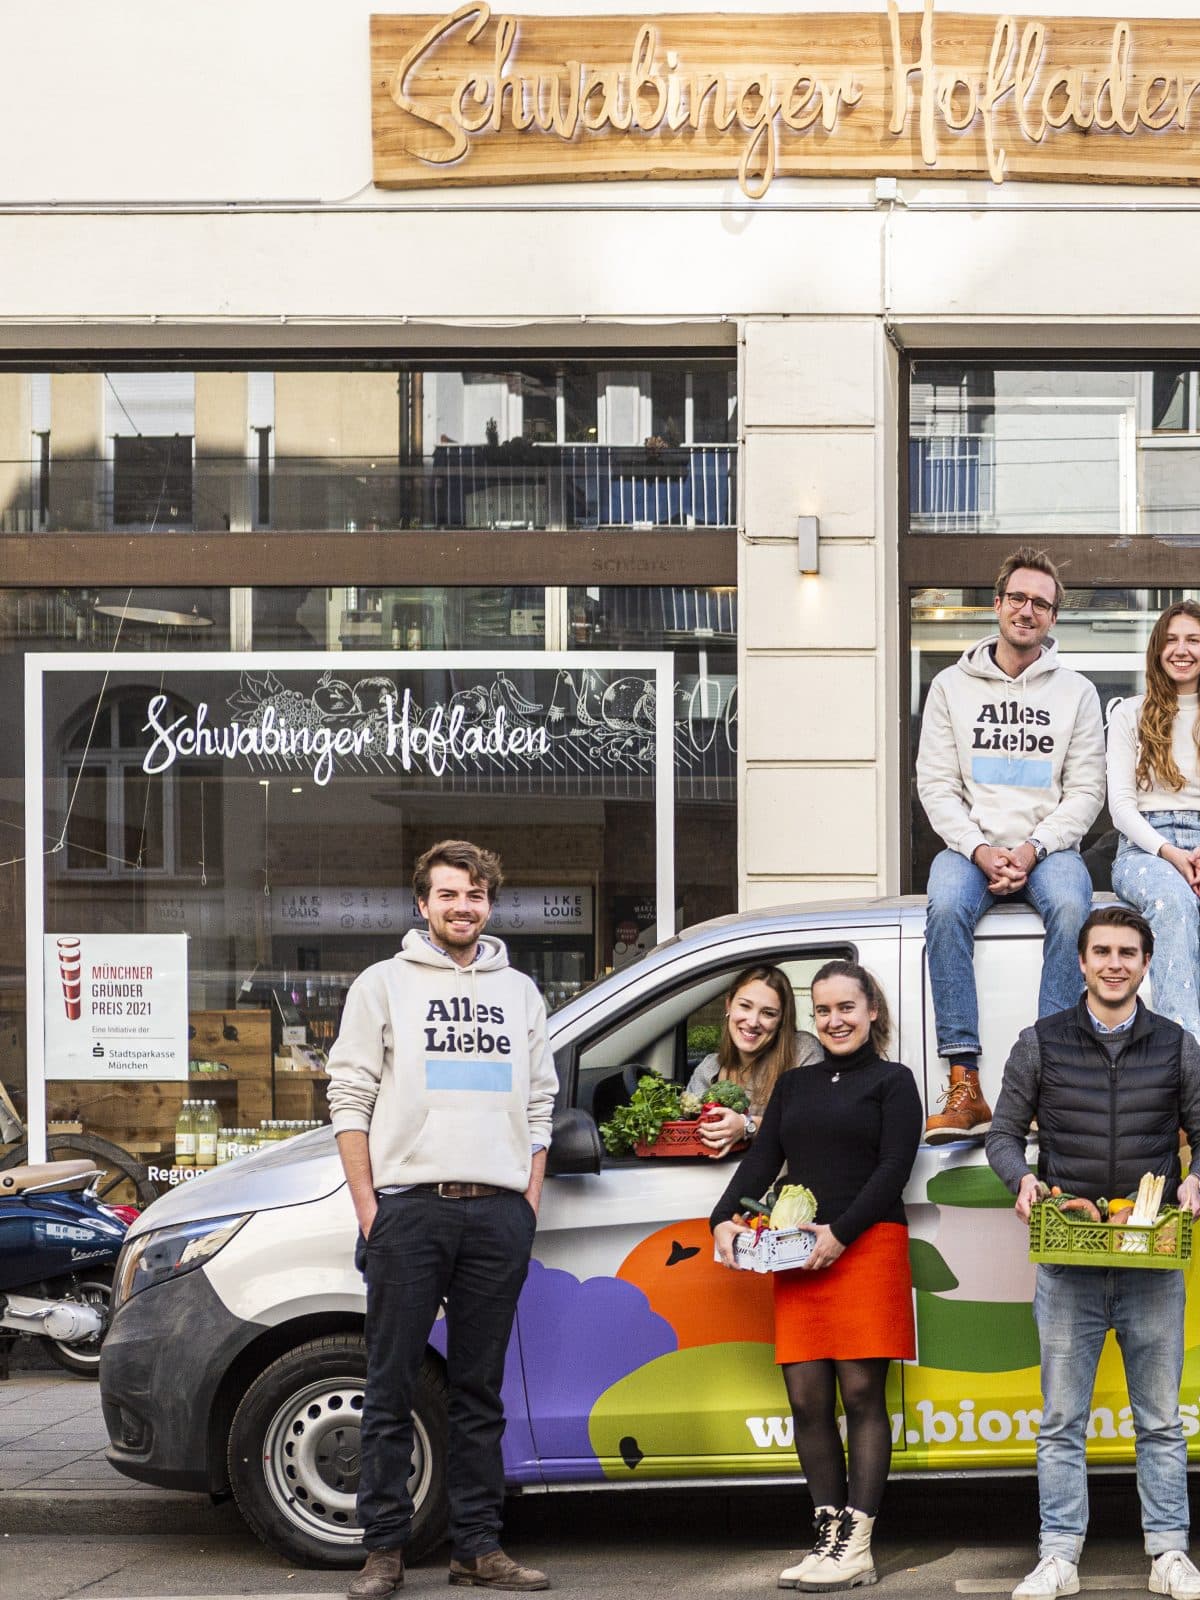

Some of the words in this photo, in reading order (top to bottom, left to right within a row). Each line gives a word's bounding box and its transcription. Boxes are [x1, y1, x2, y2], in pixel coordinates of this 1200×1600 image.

[391, 0, 862, 199] Schwabinger
[976, 700, 1051, 726] Alles
[141, 694, 374, 786] Schwabinger
[385, 688, 551, 777] Hofladen
[971, 727, 1055, 754] Liebe
[544, 896, 582, 905] LIKE
[544, 907, 582, 917] LOUIS
[92, 963, 153, 980] MÜNCHNER
[92, 981, 143, 998] GRÜNDER
[92, 1002, 123, 1015] PREIS
[126, 1002, 151, 1015] 2021
[425, 996, 505, 1025] Alles
[107, 1025, 137, 1033] Initiative
[138, 1025, 150, 1033] der
[423, 1025, 511, 1055] Liebe
[108, 1048, 176, 1060] Stadtsparkasse
[108, 1061, 148, 1070] München
